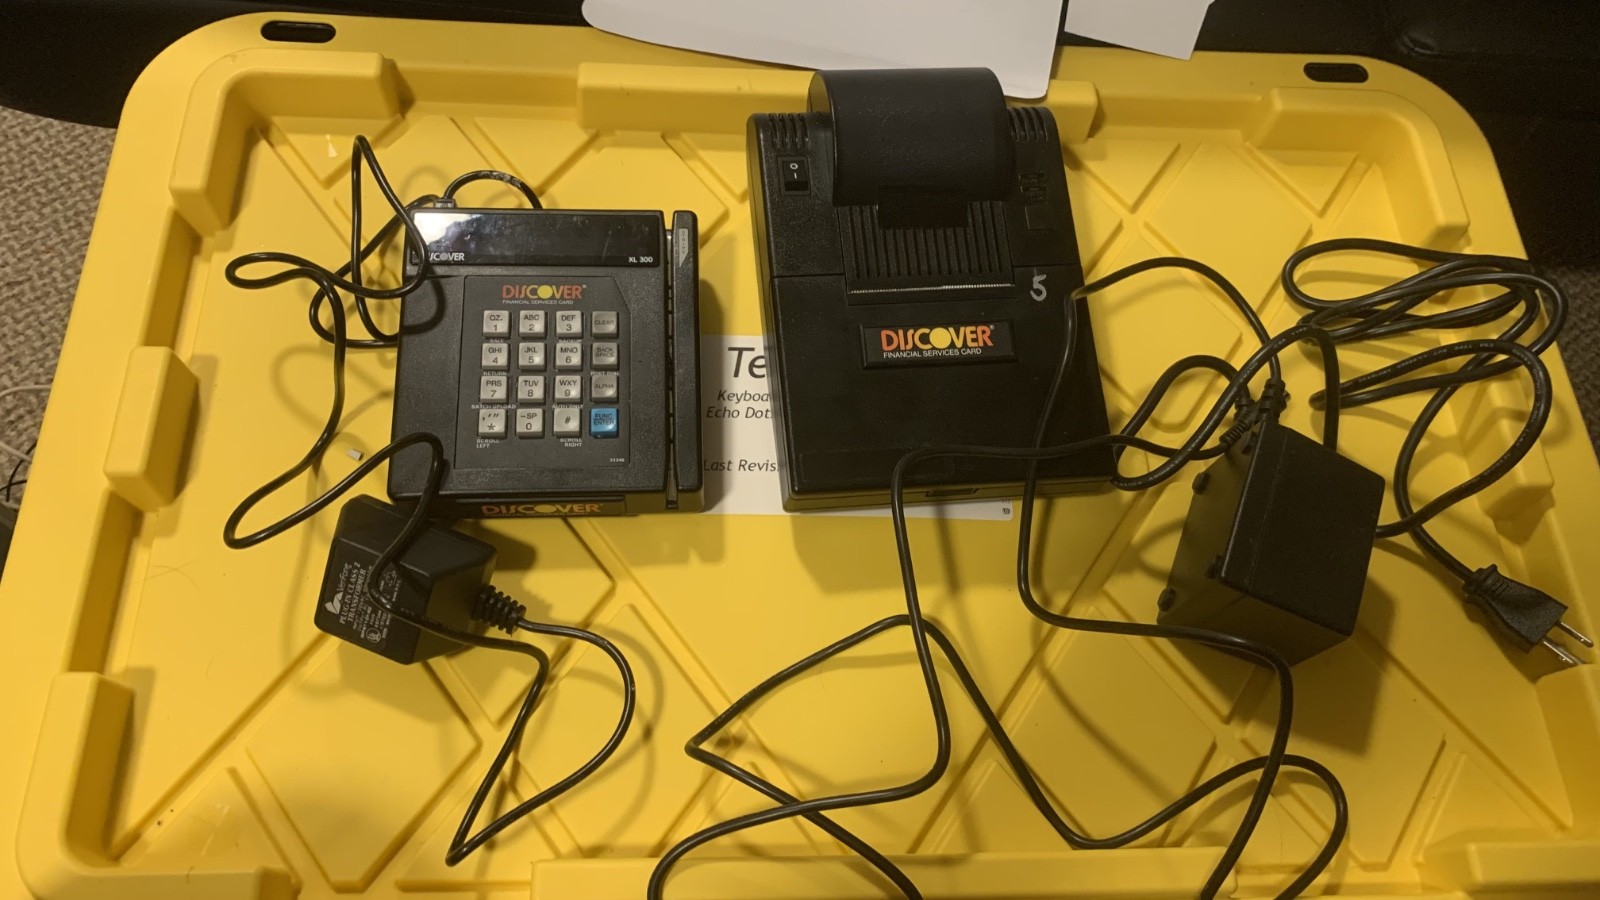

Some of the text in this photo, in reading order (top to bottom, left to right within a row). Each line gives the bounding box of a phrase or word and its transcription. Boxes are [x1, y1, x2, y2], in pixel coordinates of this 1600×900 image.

[429, 252, 464, 260] SCOVER
[502, 284, 582, 299] DISCOVER
[1030, 274, 1046, 301] 5
[880, 326, 994, 351] DISCOVER
[884, 350, 922, 358] FINANCIAL
[922, 348, 960, 357] SERVICES
[706, 406, 740, 418] Echo
[526, 422, 532, 430] 0
[564, 416, 570, 424] #
[704, 460, 732, 472] Last
[481, 503, 600, 514] DISCOVER
[348, 569, 358, 593] CLASS
[347, 568, 366, 622] TRANSFORMER
